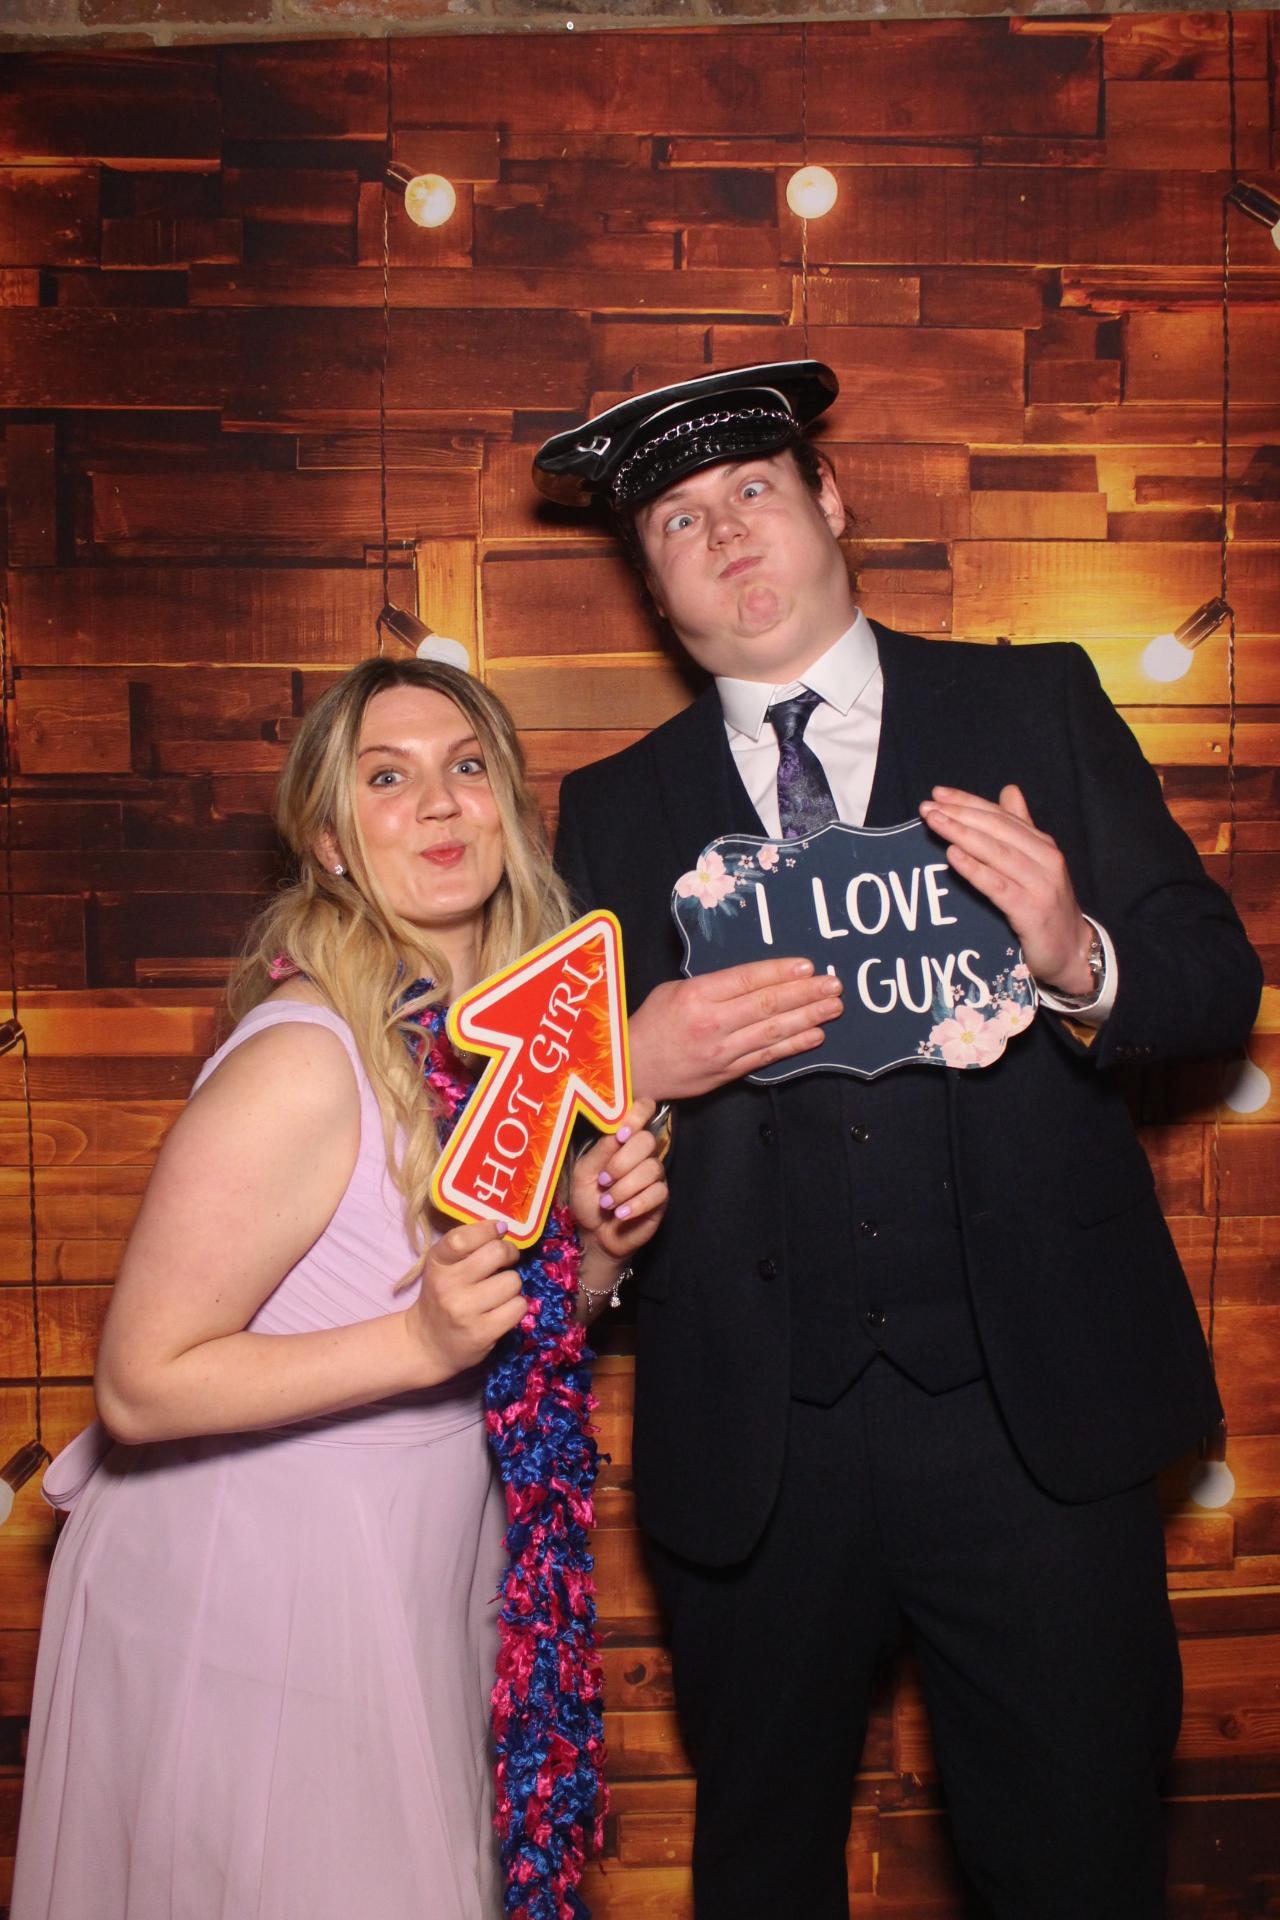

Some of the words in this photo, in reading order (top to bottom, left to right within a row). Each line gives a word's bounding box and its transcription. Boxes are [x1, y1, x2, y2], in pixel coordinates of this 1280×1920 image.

[755, 882, 773, 945] I
[812, 863, 958, 940] LOVE
[857, 949, 990, 1014] GUYS
[473, 1073, 544, 1204] HOT
[529, 960, 605, 1074] GIRL
